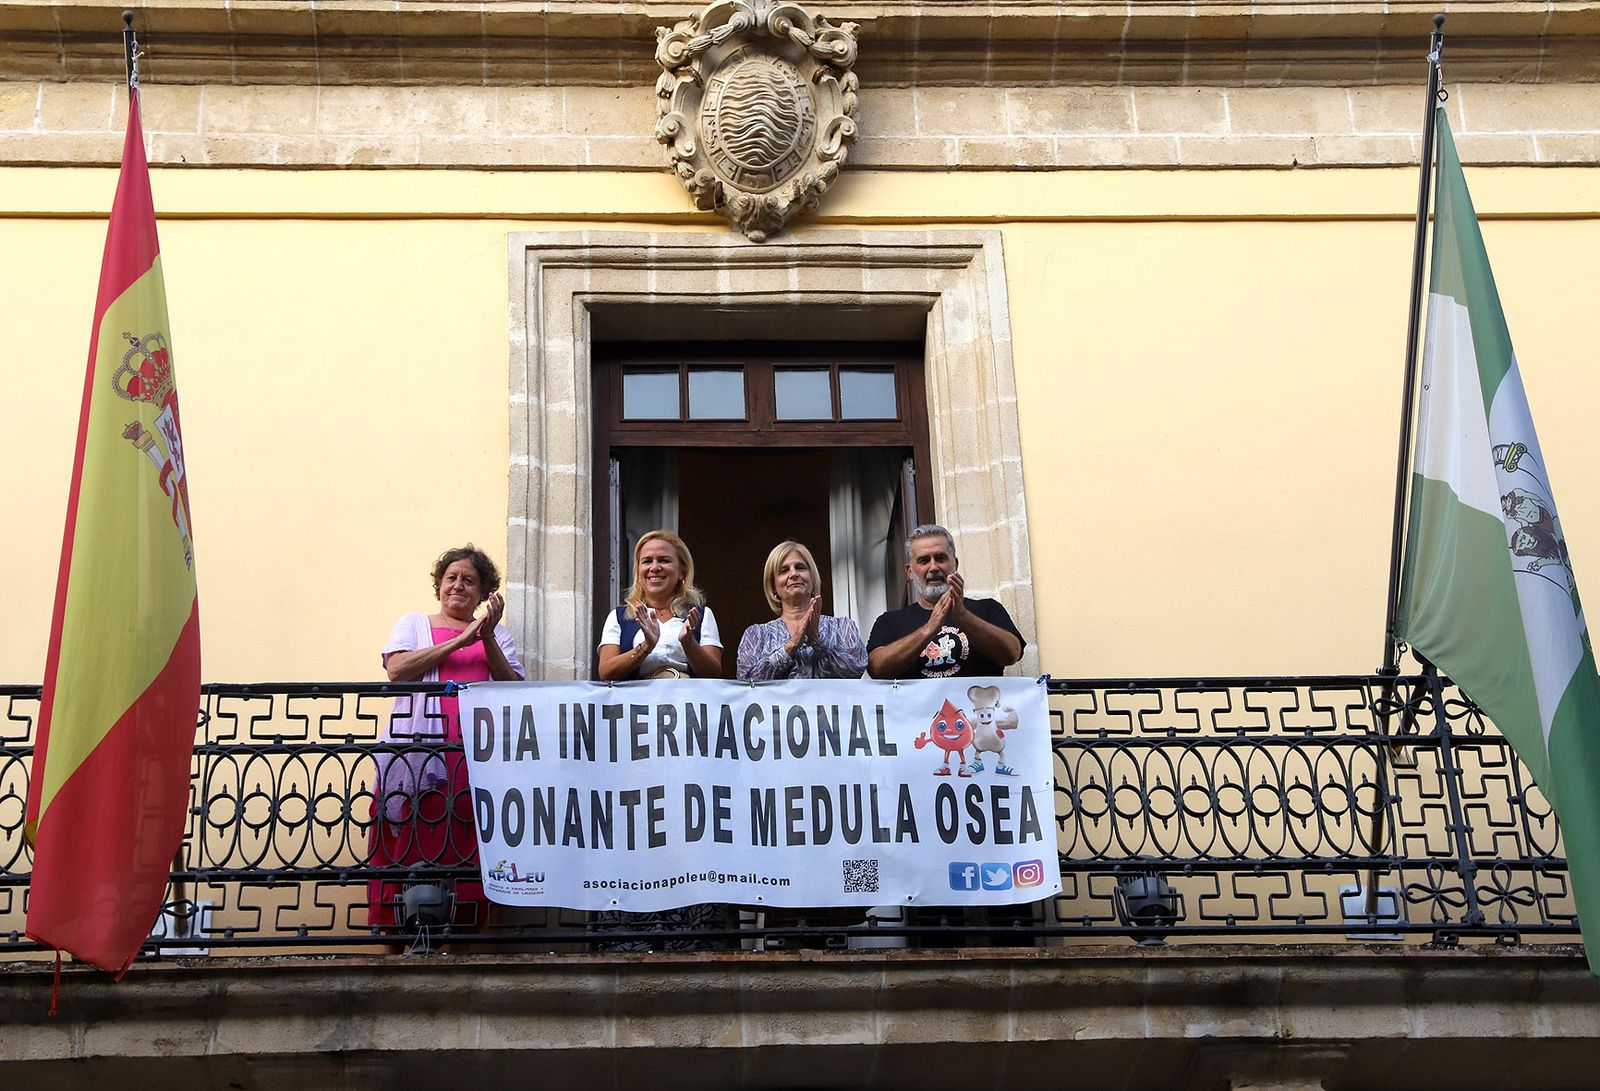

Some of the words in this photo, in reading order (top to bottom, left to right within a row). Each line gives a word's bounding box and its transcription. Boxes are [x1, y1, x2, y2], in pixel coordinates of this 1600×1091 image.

[473, 704, 540, 762] DIA
[559, 702, 897, 762] INTERNACIONAL
[475, 785, 666, 850] DONANTE
[684, 783, 733, 844] DE
[750, 783, 919, 847] MEDULA
[935, 782, 1043, 845] OSEA
[583, 870, 790, 890] asociacionapoleu@gmail.com
